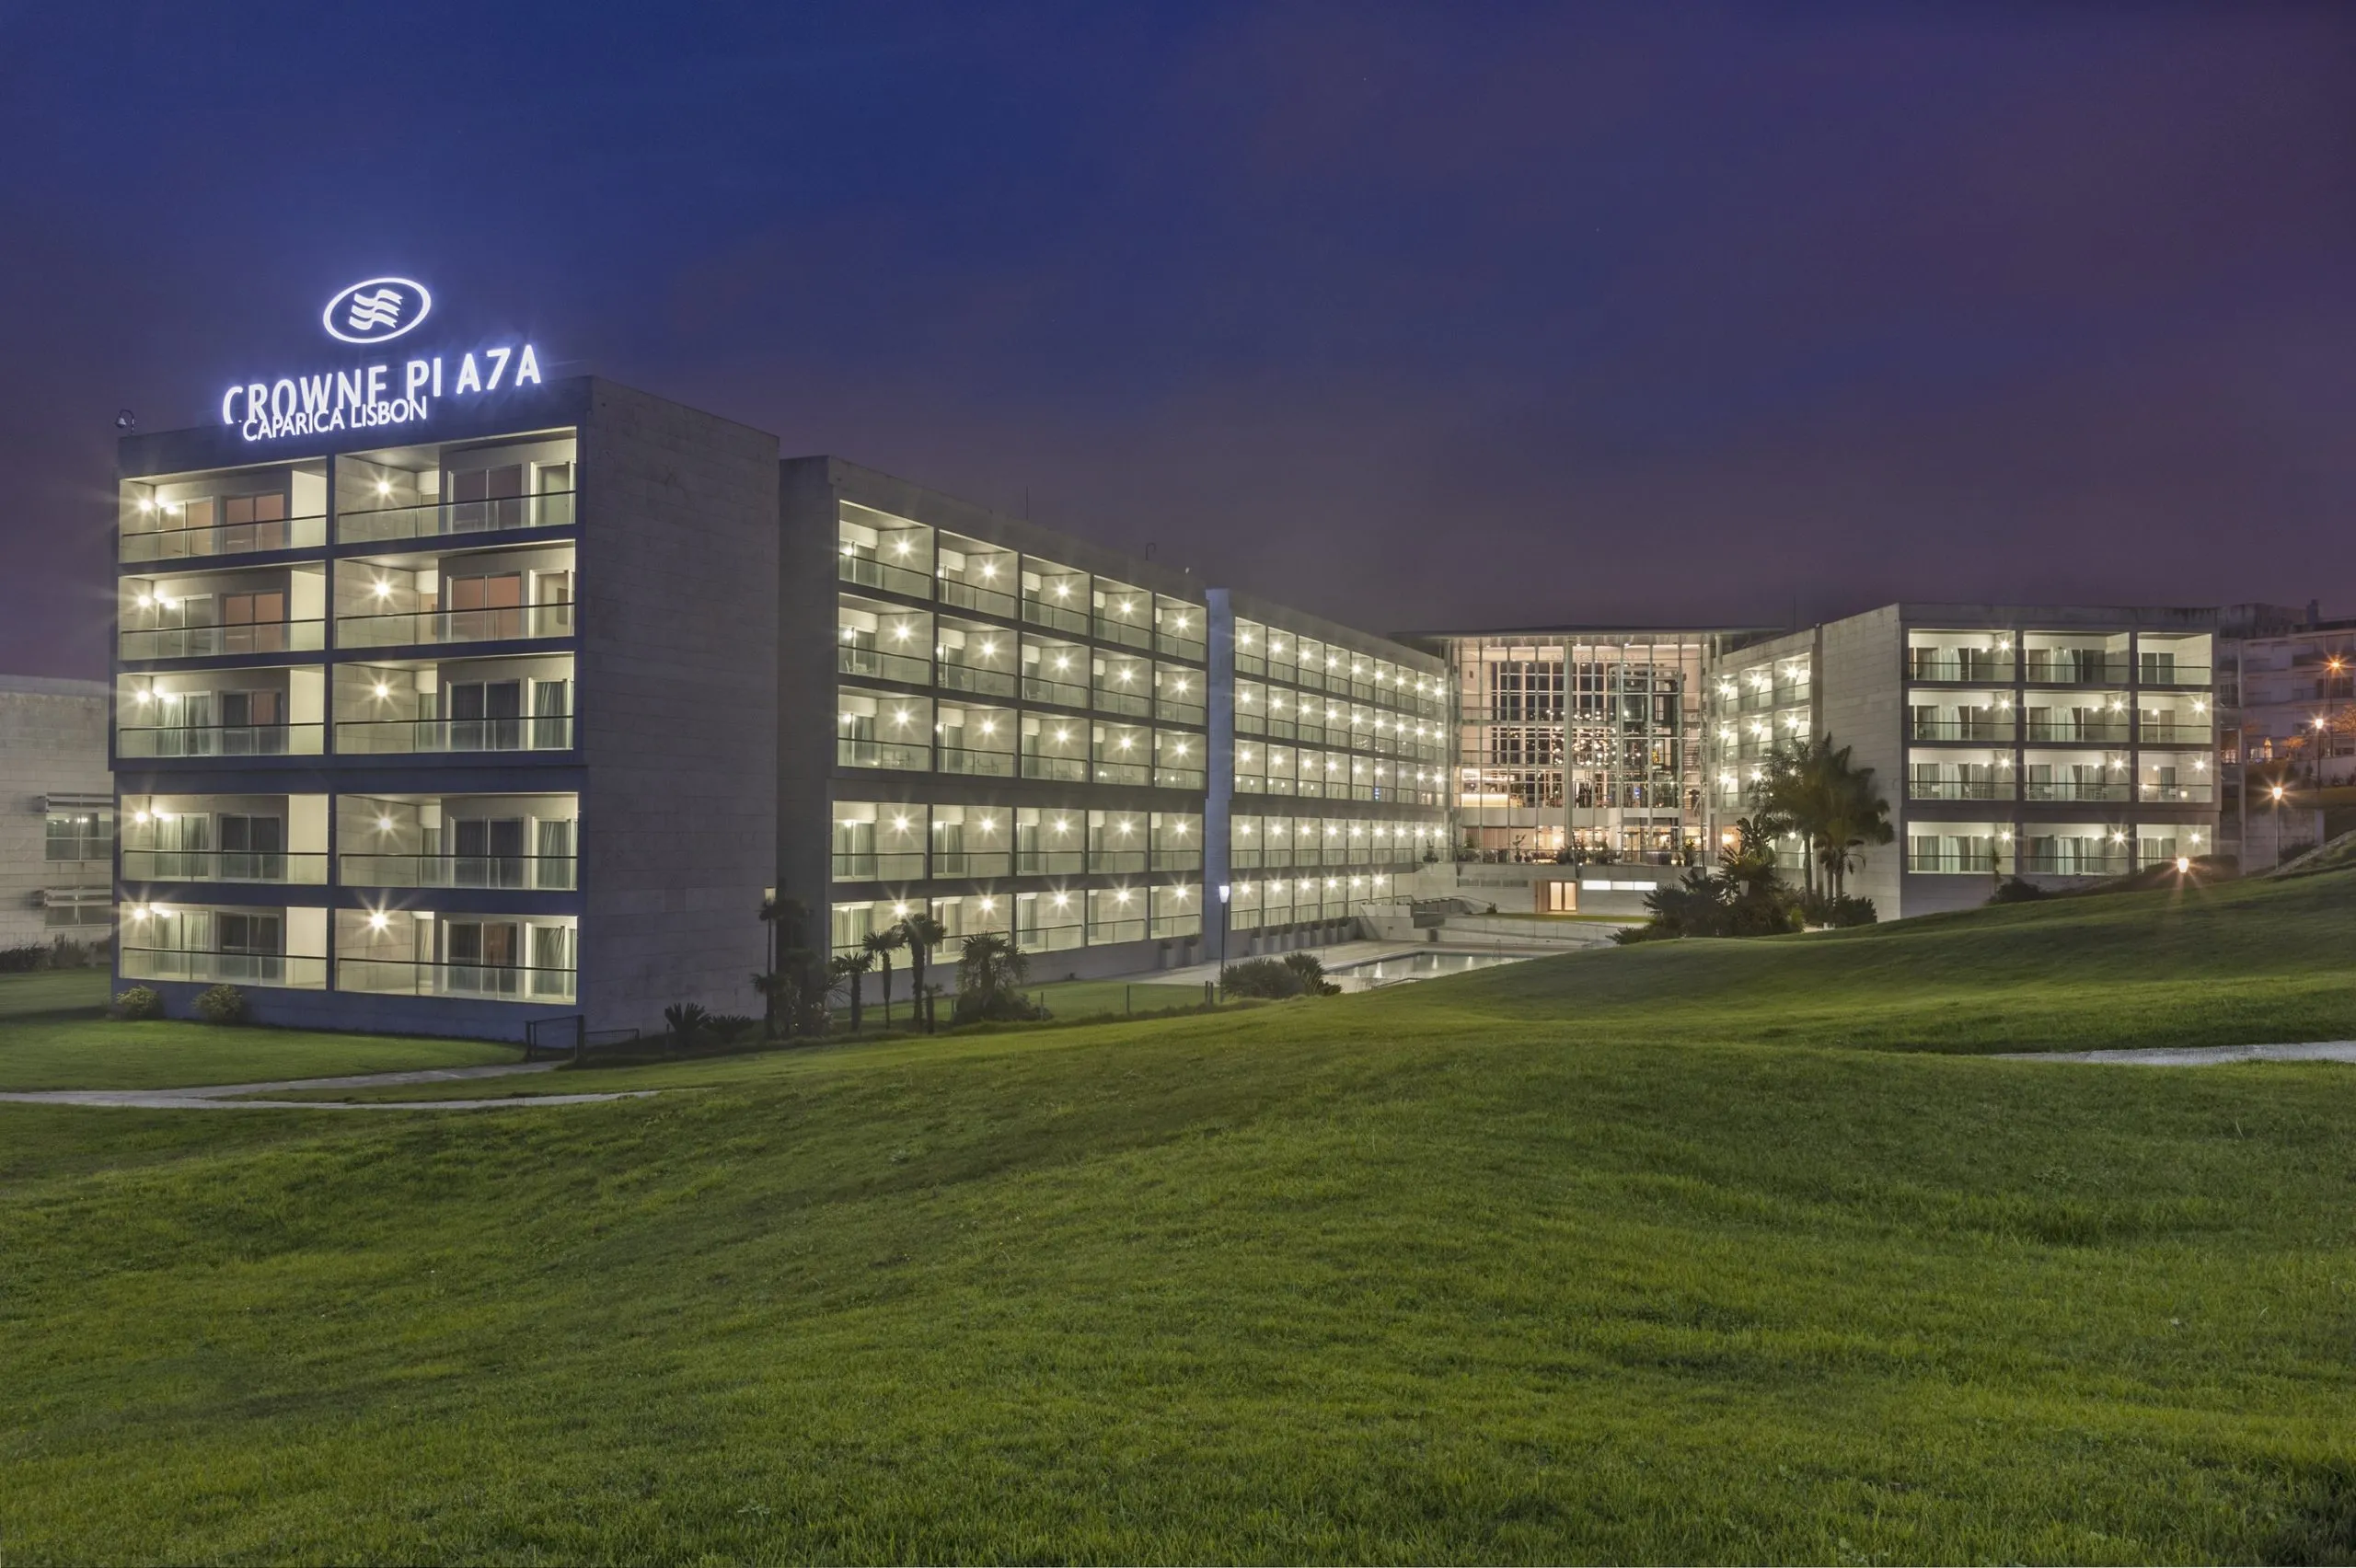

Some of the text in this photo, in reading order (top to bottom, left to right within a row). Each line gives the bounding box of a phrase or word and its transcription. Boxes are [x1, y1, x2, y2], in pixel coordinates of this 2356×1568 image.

[223, 365, 387, 424] CROWNE
[242, 396, 427, 442] CAPARICA LISBON
